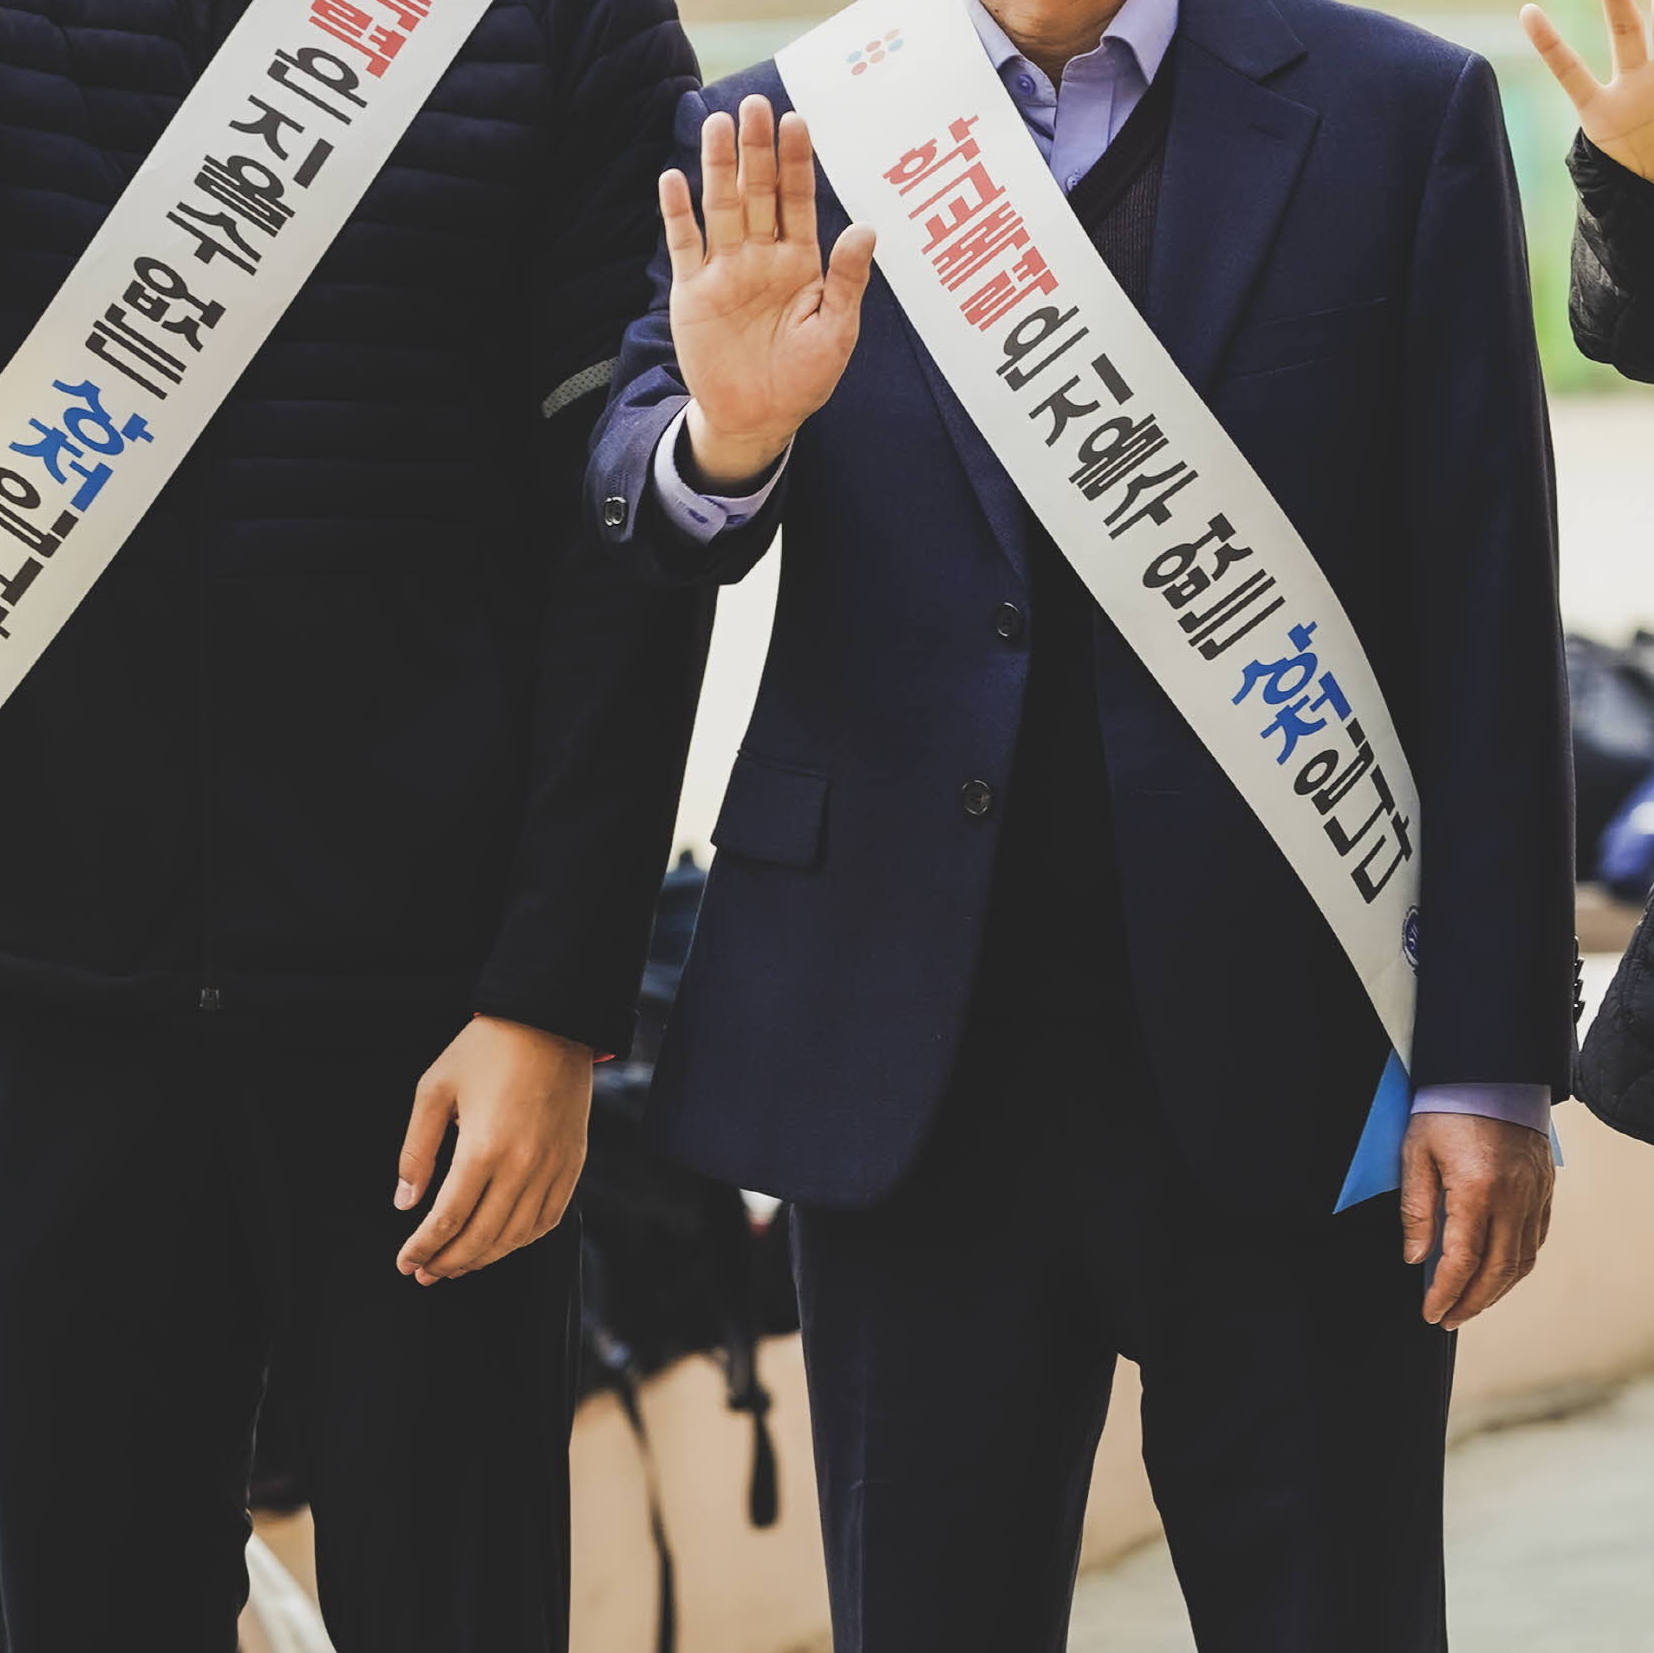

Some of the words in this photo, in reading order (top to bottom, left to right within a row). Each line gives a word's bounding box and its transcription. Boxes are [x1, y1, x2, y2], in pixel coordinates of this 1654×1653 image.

[83, 255, 228, 402] 없는
[1141, 511, 1287, 662] 없는
[1230, 620, 1417, 906] 상처입니다
